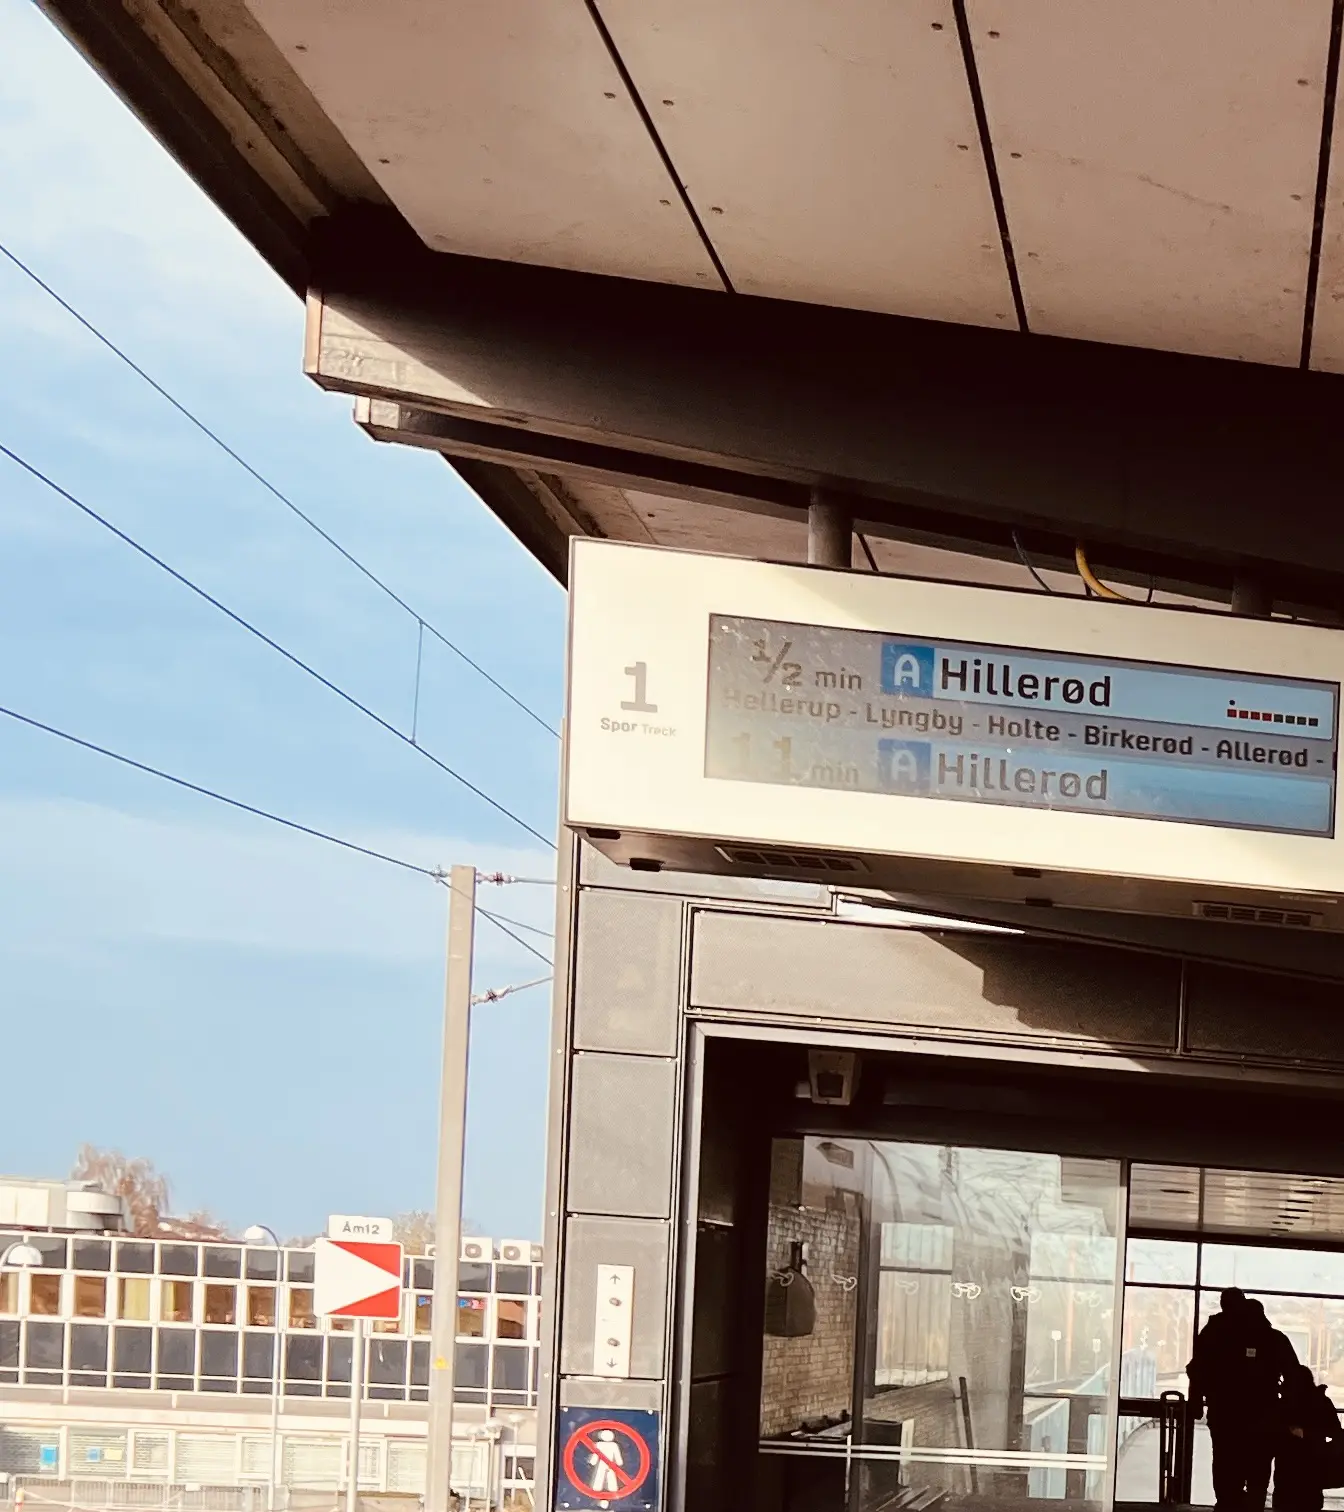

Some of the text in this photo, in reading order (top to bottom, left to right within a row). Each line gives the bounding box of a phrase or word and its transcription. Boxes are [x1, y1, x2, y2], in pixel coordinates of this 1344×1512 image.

[619, 661, 659, 714] 1
[815, 667, 863, 692] min
[941, 657, 1112, 708] Hillerød
[600, 717, 677, 738] Spor Track
[866, 704, 965, 735] Lyngby
[987, 717, 1061, 743] Holte
[1083, 724, 1194, 757] Birkerød
[1215, 738, 1309, 768] Allerød
[809, 760, 860, 785] min
[936, 751, 1108, 801] Hillerød
